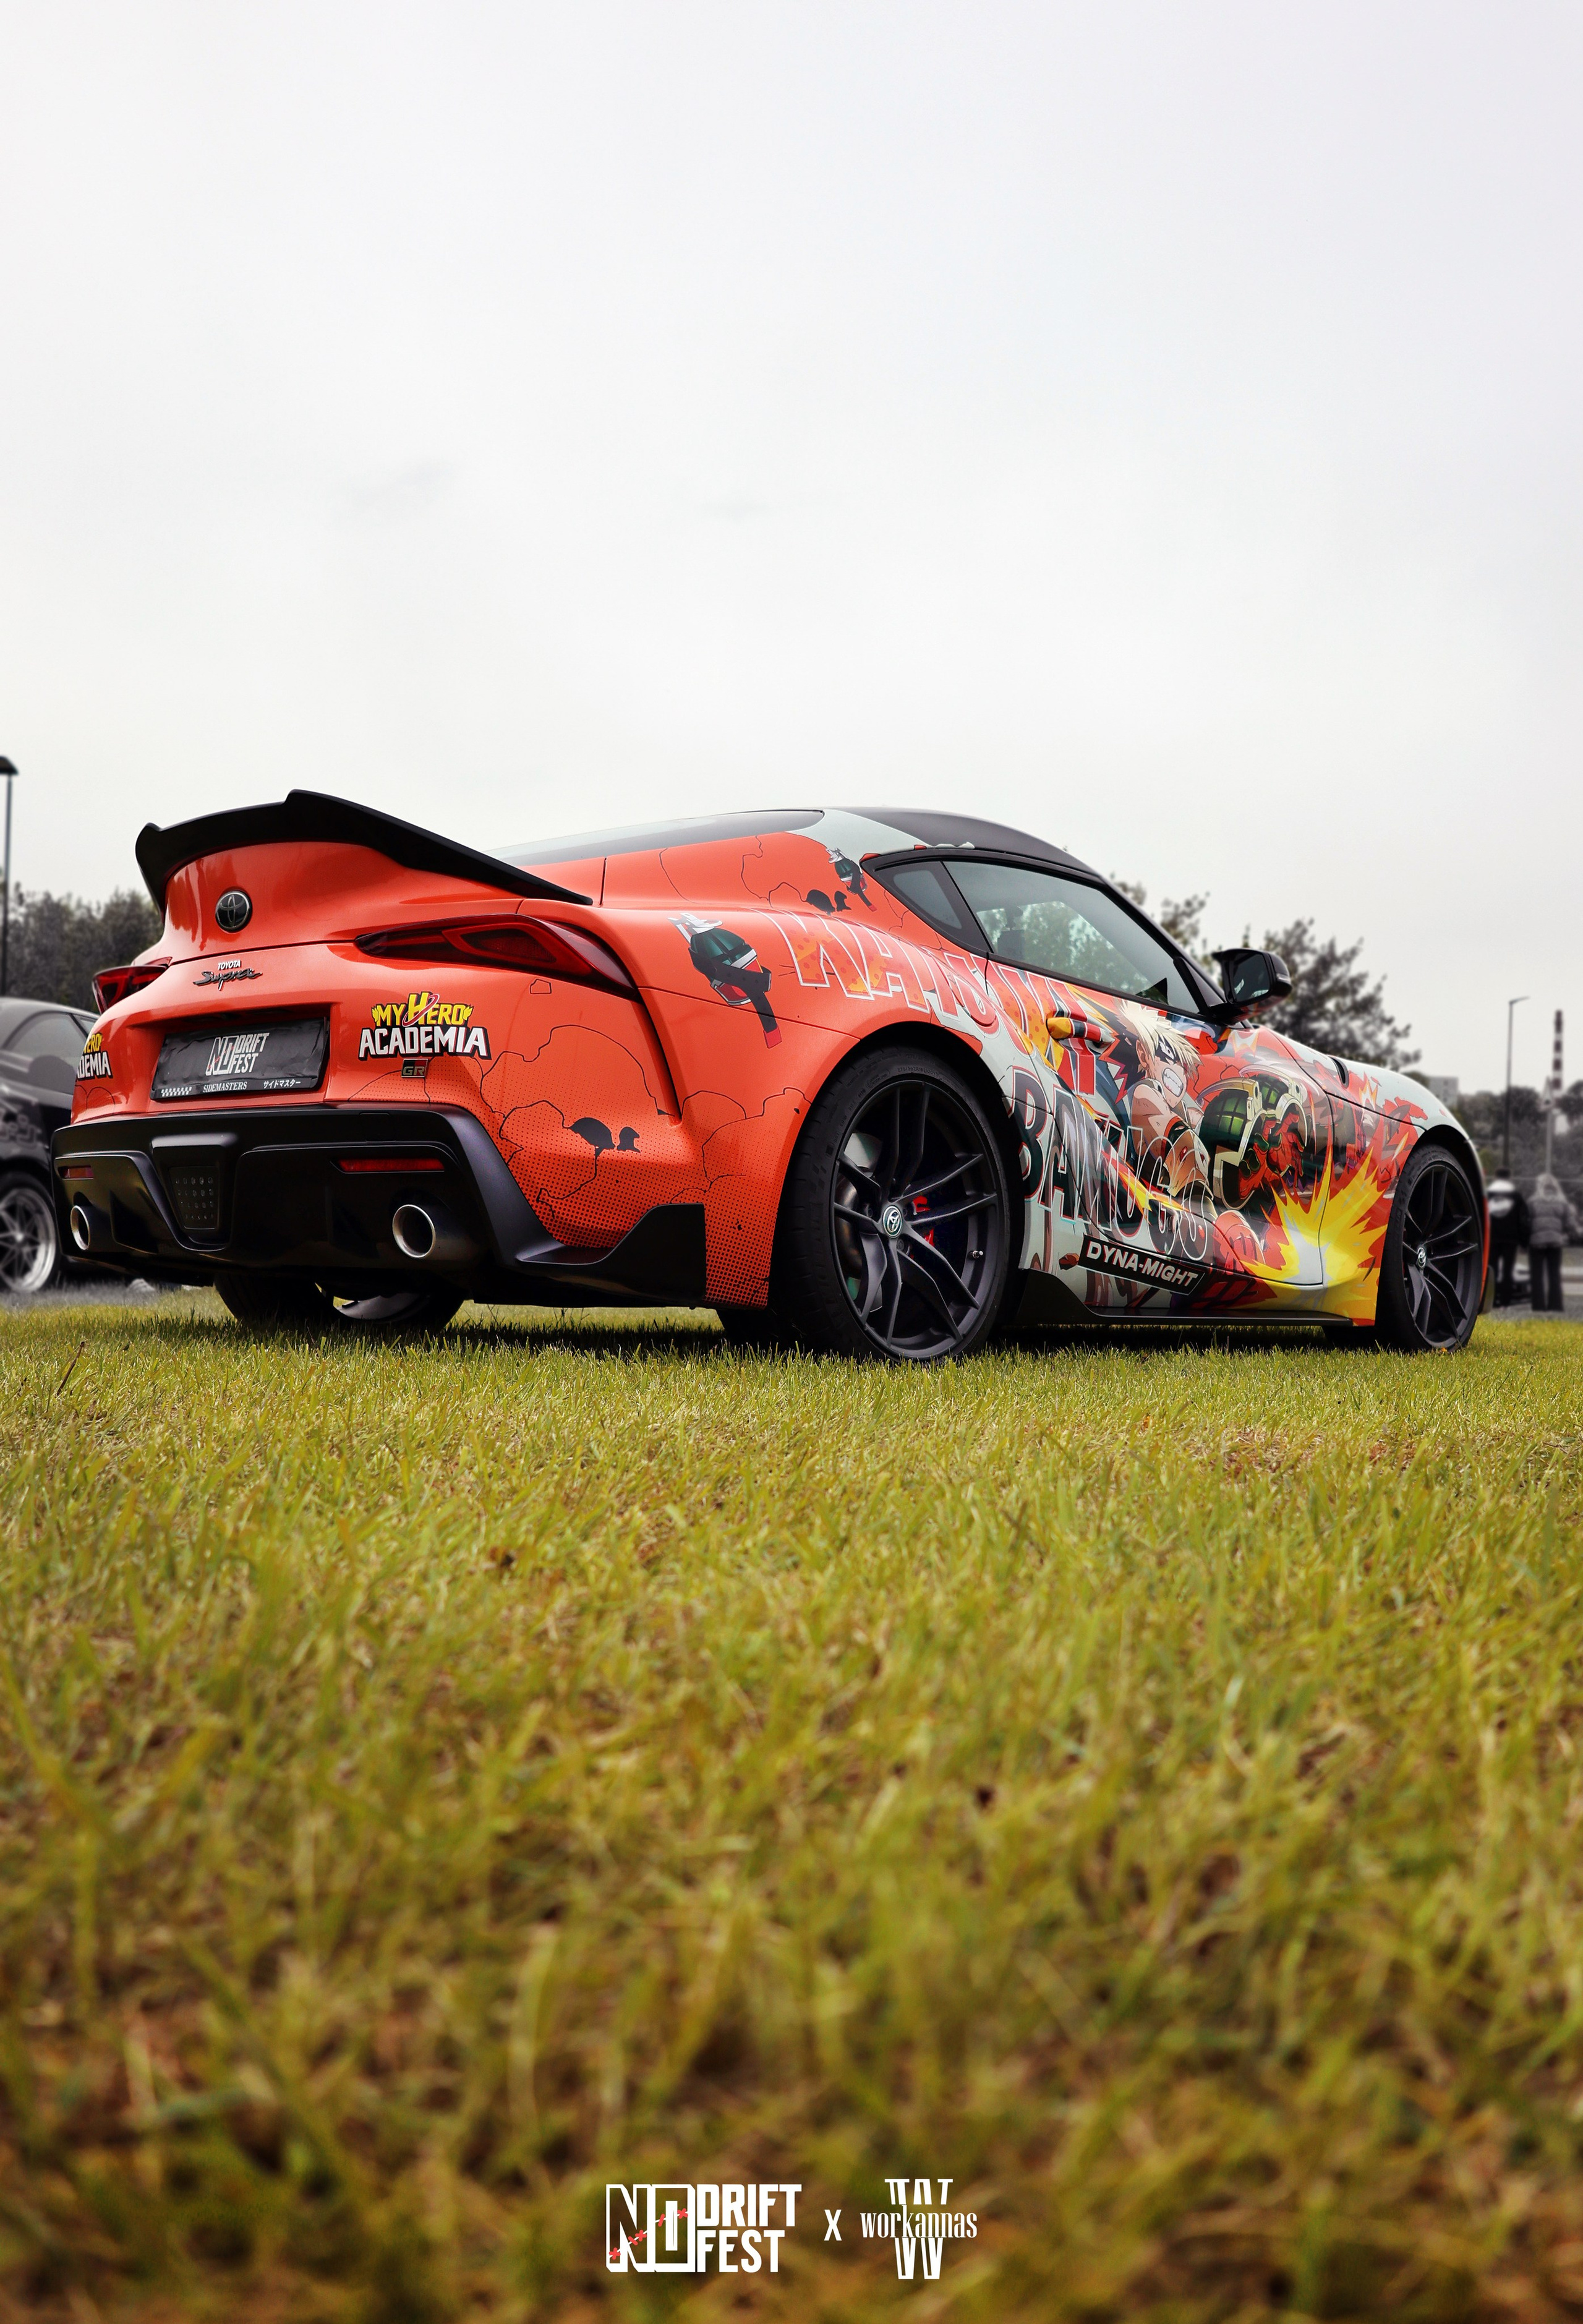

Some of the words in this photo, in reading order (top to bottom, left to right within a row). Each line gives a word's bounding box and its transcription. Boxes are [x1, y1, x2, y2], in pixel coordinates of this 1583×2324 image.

[218, 960, 241, 970] TOYOTA
[193, 968, 263, 991] Supra
[376, 1004, 406, 1027] MY
[408, 991, 467, 1025] HERO
[235, 1033, 270, 1054] DRIFT
[359, 1025, 488, 1058] ACADEMIA
[231, 1053, 259, 1074] FEST
[403, 1065, 425, 1077] GR
[203, 1081, 247, 1093] SIDEMASTERS
[263, 1079, 301, 1089] サイドマスター
[1086, 1241, 1198, 1287] DYNA-MIGHT
